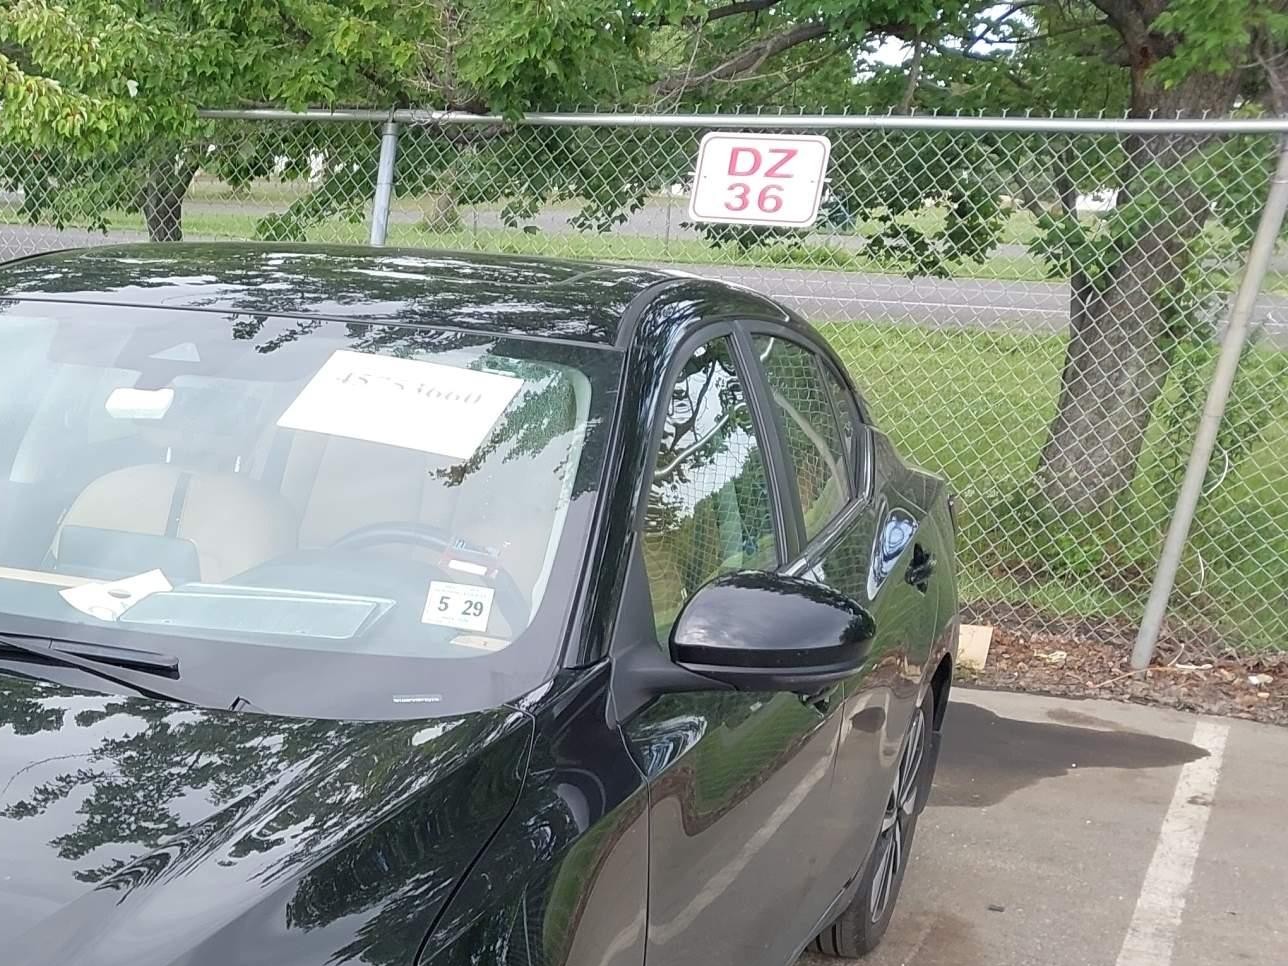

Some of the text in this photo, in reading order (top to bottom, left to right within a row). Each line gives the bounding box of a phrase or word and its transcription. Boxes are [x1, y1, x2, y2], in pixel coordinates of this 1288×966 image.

[727, 147, 798, 178] DZ
[724, 182, 784, 213] 36
[437, 596, 484, 617] 5 29
